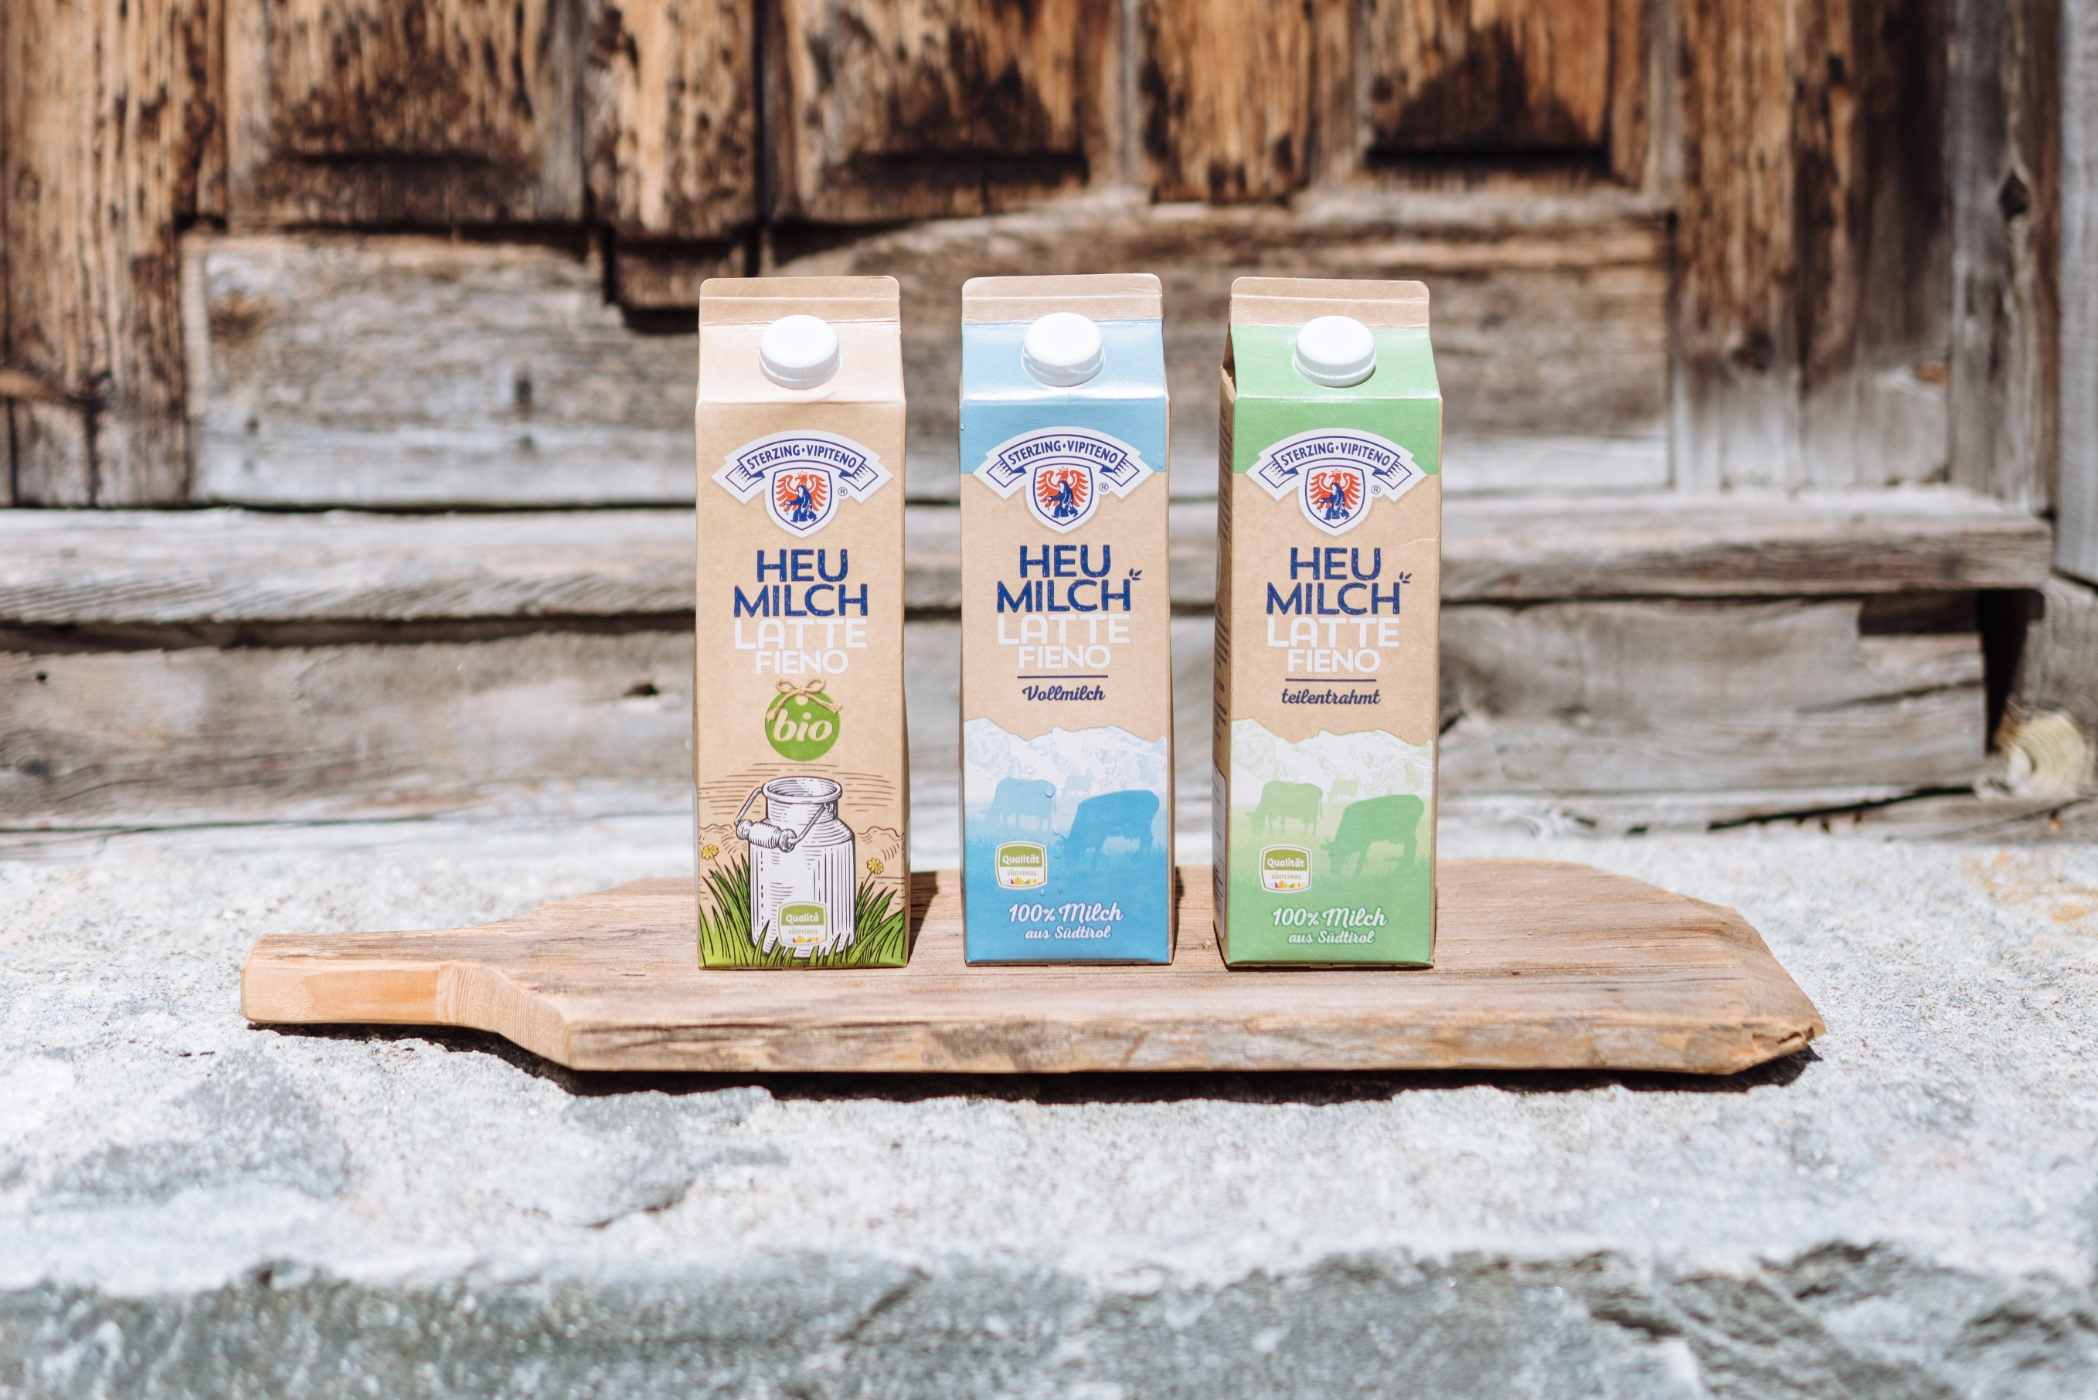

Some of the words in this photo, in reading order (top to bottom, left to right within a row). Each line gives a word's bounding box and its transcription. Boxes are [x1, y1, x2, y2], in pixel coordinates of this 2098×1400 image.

[746, 444, 800, 470] STERZING
[806, 444, 857, 468] VIPITENO
[1008, 440, 1061, 465] STERZING
[1067, 440, 1118, 464] VIPITENO
[1280, 442, 1334, 466] STERZING
[1340, 442, 1391, 466] VIPITENO
[757, 549, 848, 582] HEU
[1020, 544, 1111, 578] HEU
[1290, 547, 1381, 581] HEU
[734, 583, 868, 617] MILCH
[997, 579, 1131, 613] MILCH
[1266, 582, 1400, 615] MILCH
[734, 618, 868, 649] LATTE
[997, 614, 1130, 644] LATTE
[1267, 617, 1400, 647] LATTE
[756, 650, 849, 675] FIENO
[1019, 645, 1111, 669] FIENO
[1287, 649, 1381, 673] FIENO
[1022, 685, 1105, 701] Vollmilch
[1281, 689, 1381, 705] teilentrahmt
[773, 709, 833, 742] bio
[1002, 854, 1040, 865] Qualität
[1267, 858, 1305, 868] Qualität
[1008, 903, 1056, 923] 100%
[1058, 902, 1123, 924] Milch
[1272, 907, 1320, 926] 100%
[1322, 906, 1387, 928] Milch
[1025, 930, 1051, 939] aus
[1054, 925, 1111, 939] Südtirol
[1288, 934, 1314, 943] aus
[1318, 930, 1375, 944] Südtirol
